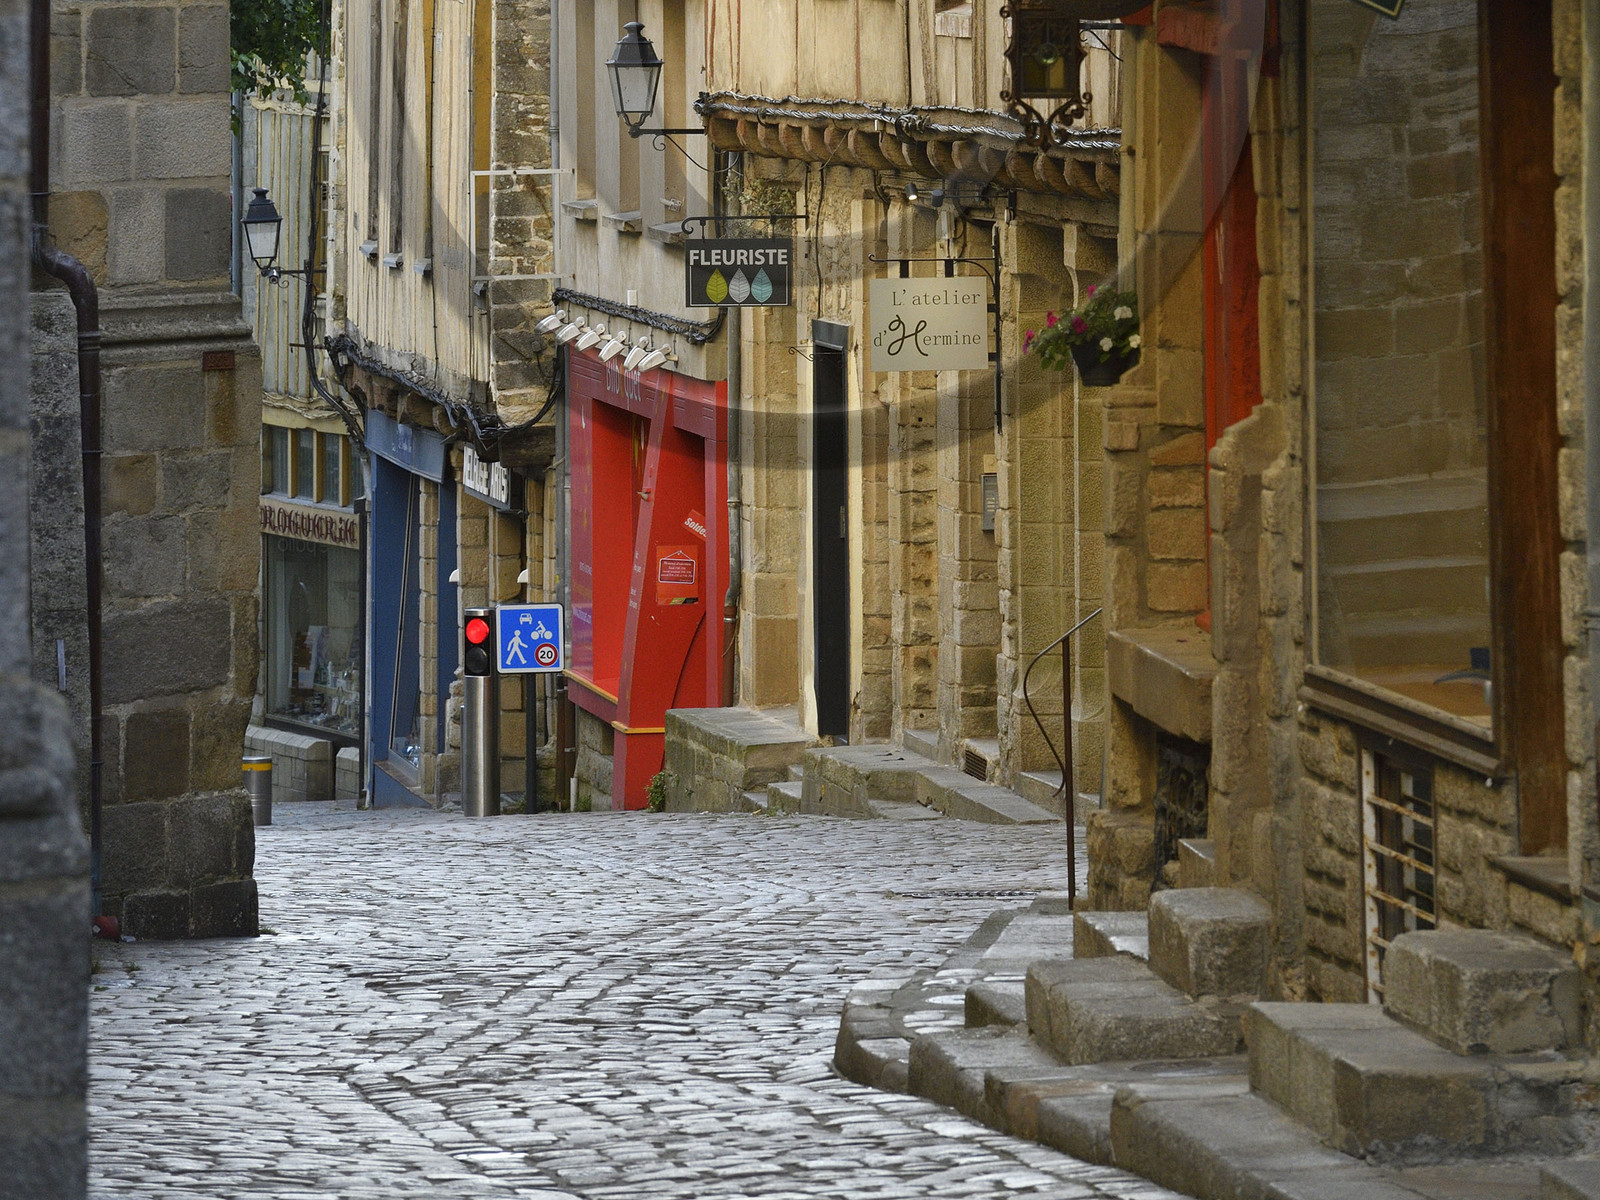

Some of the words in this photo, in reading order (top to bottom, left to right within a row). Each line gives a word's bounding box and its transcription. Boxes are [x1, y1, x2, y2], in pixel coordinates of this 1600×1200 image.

[689, 249, 788, 266] FLEURISTE
[684, 517, 707, 537] Solde
[539, 650, 554, 660] 20
